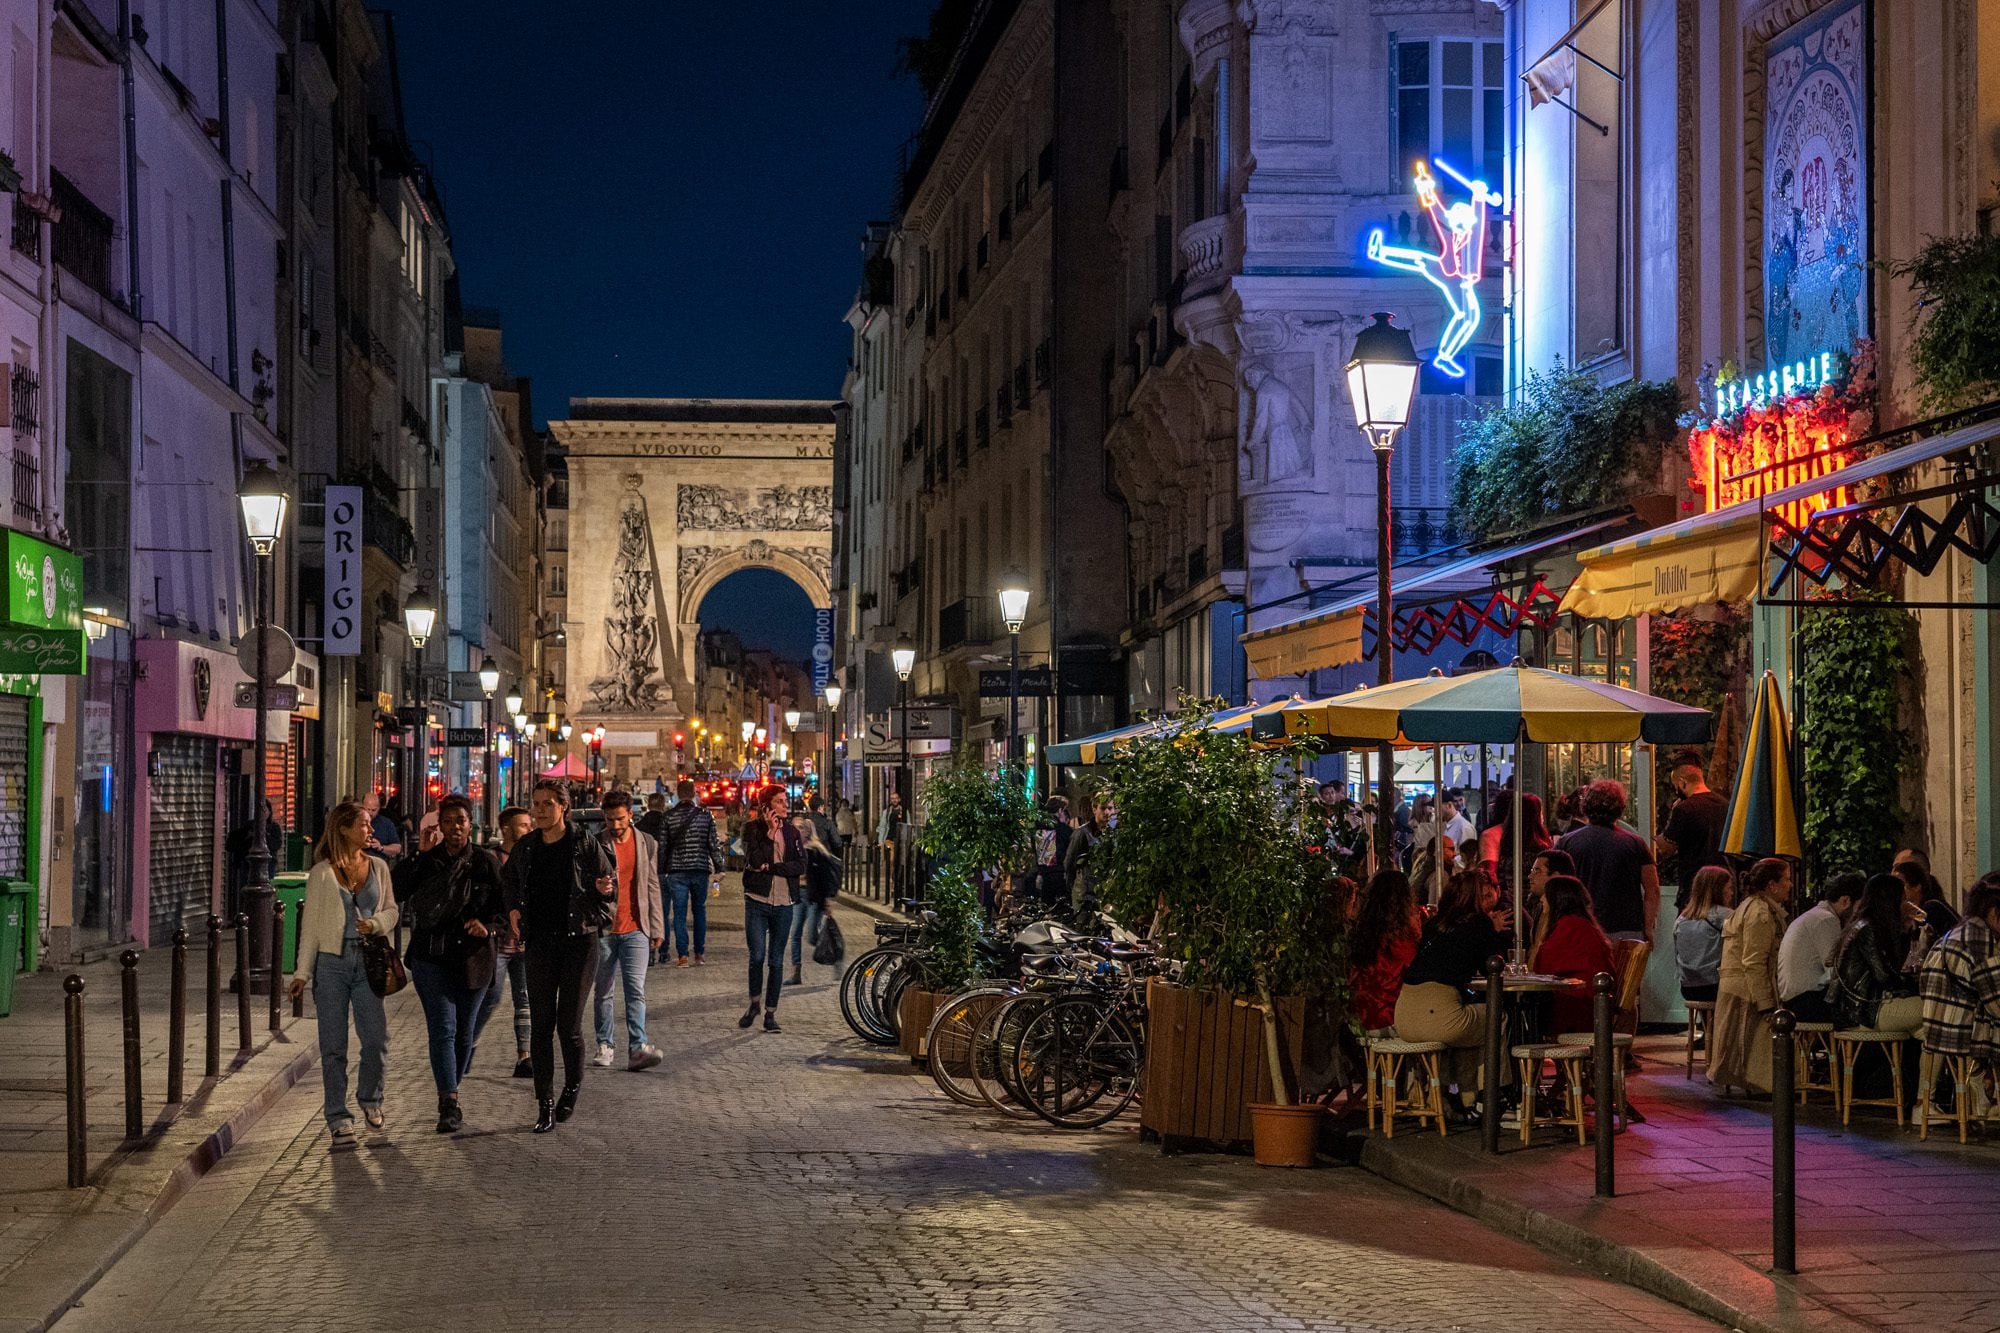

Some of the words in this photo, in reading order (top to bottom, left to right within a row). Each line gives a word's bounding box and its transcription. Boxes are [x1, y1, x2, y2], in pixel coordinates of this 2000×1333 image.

[631, 444, 721, 455] LVDOVICO
[331, 502, 354, 639] ORIGO
[1654, 564, 1688, 596] Dubillot
[816, 609, 830, 642] HOOD
[35, 649, 78, 671] Green
[814, 661, 830, 696] HOLLY
